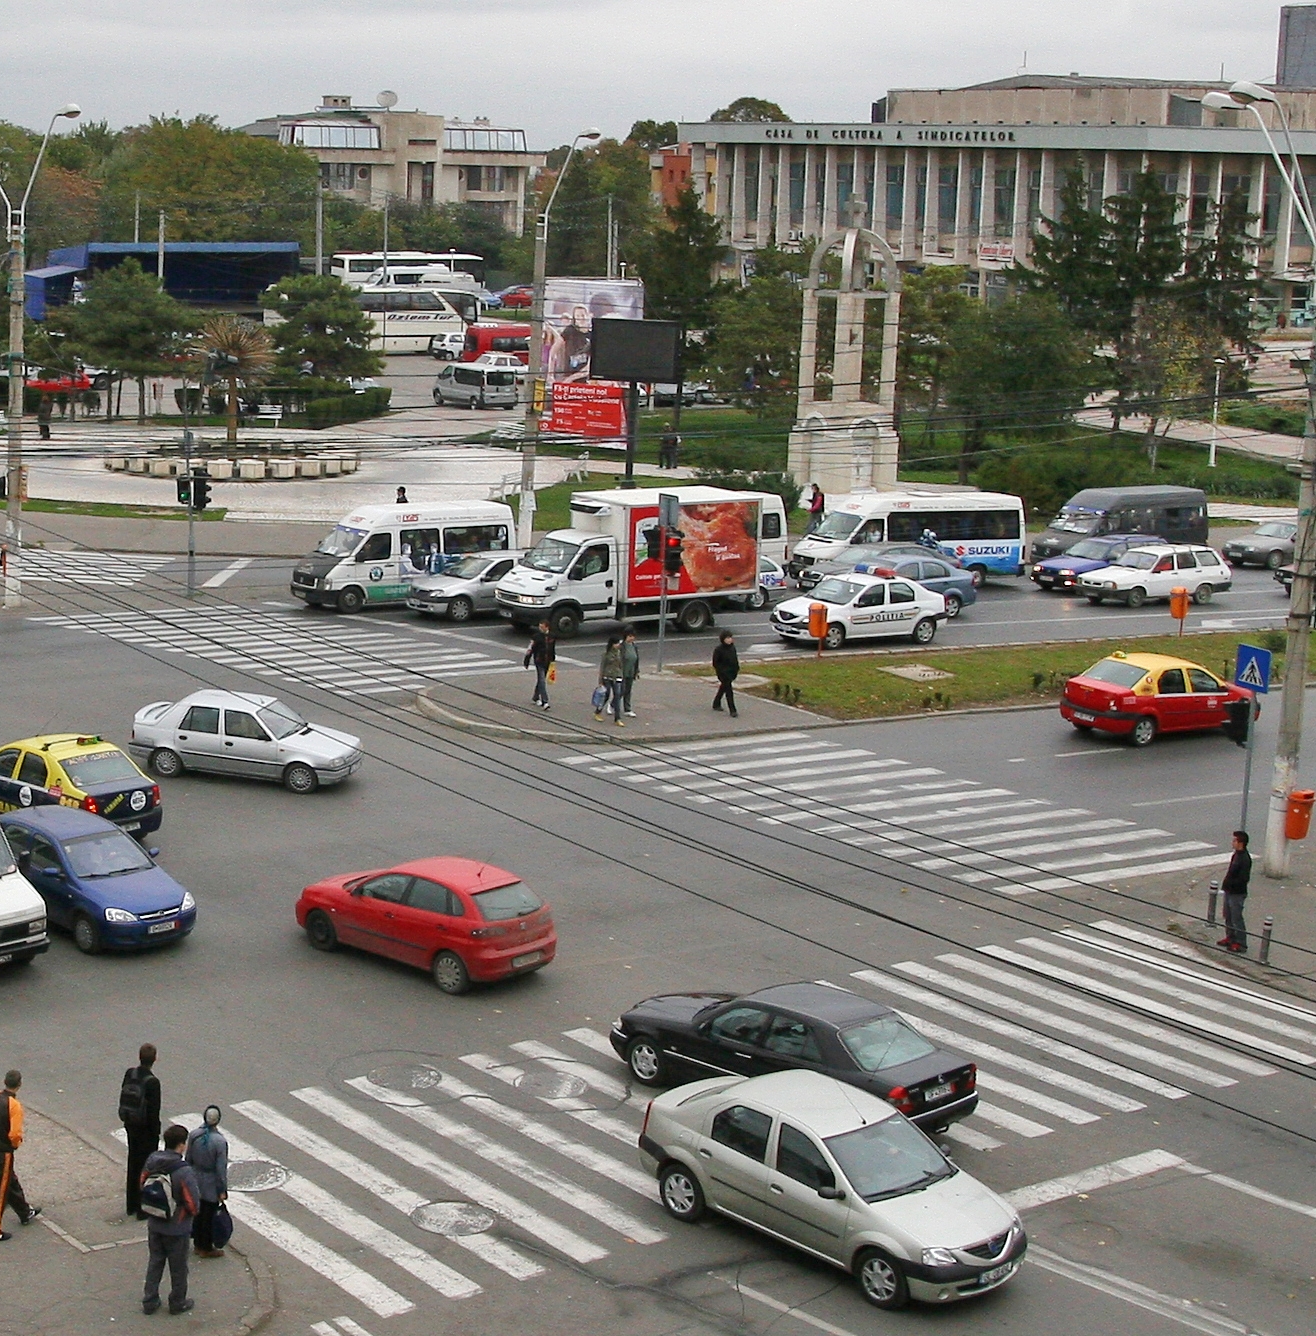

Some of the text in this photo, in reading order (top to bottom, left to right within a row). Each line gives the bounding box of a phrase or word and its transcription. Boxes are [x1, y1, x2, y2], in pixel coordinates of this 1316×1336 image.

[765, 130, 1016, 142] CASA DE CULTURA A SINDICATELOR
[968, 546, 1009, 555] SUZUKI
